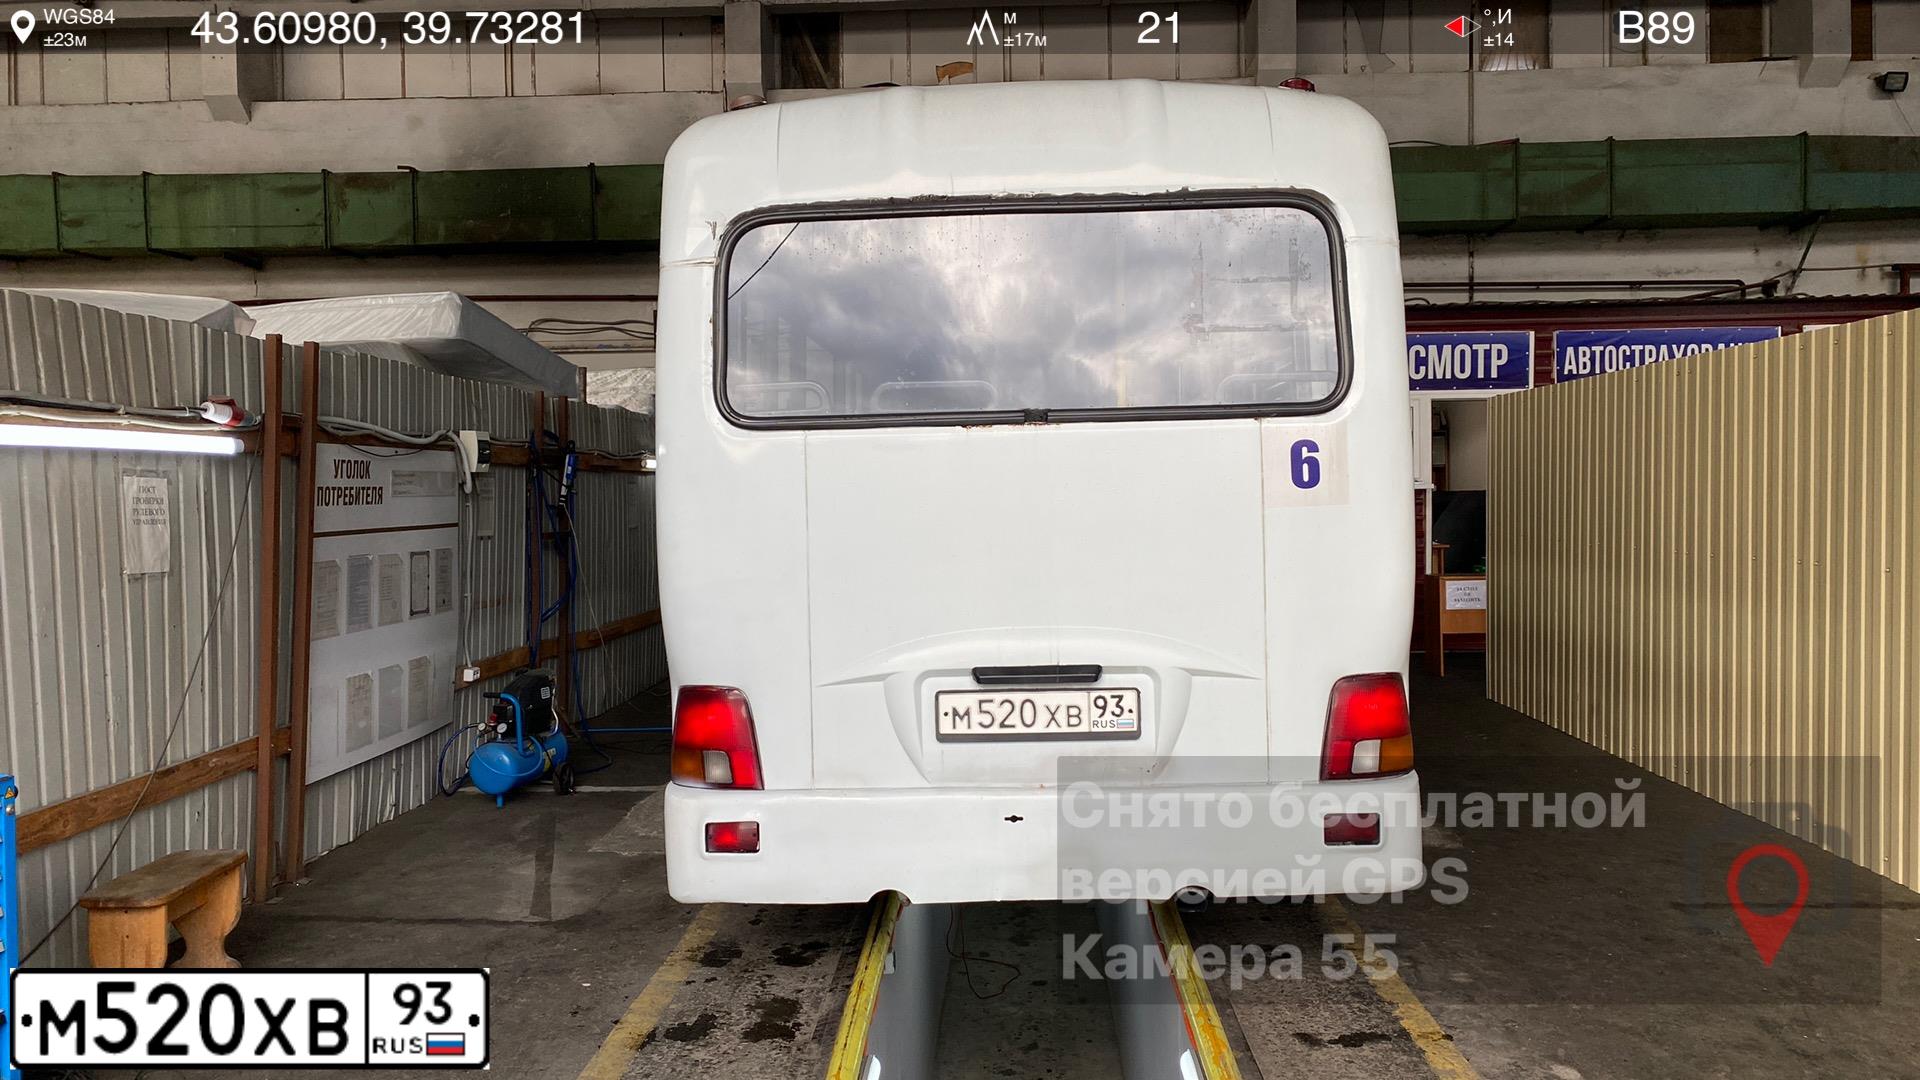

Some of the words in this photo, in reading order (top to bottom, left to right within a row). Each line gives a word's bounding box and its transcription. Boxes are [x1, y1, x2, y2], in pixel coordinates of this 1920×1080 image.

[333, 458, 371, 479] УГОЛОК
[1290, 438, 1321, 489] 6
[316, 486, 384, 507] ПОТРЕБИТЕЛЯ
[1093, 694, 1125, 719] 93
[1092, 719, 1116, 729] RUS
